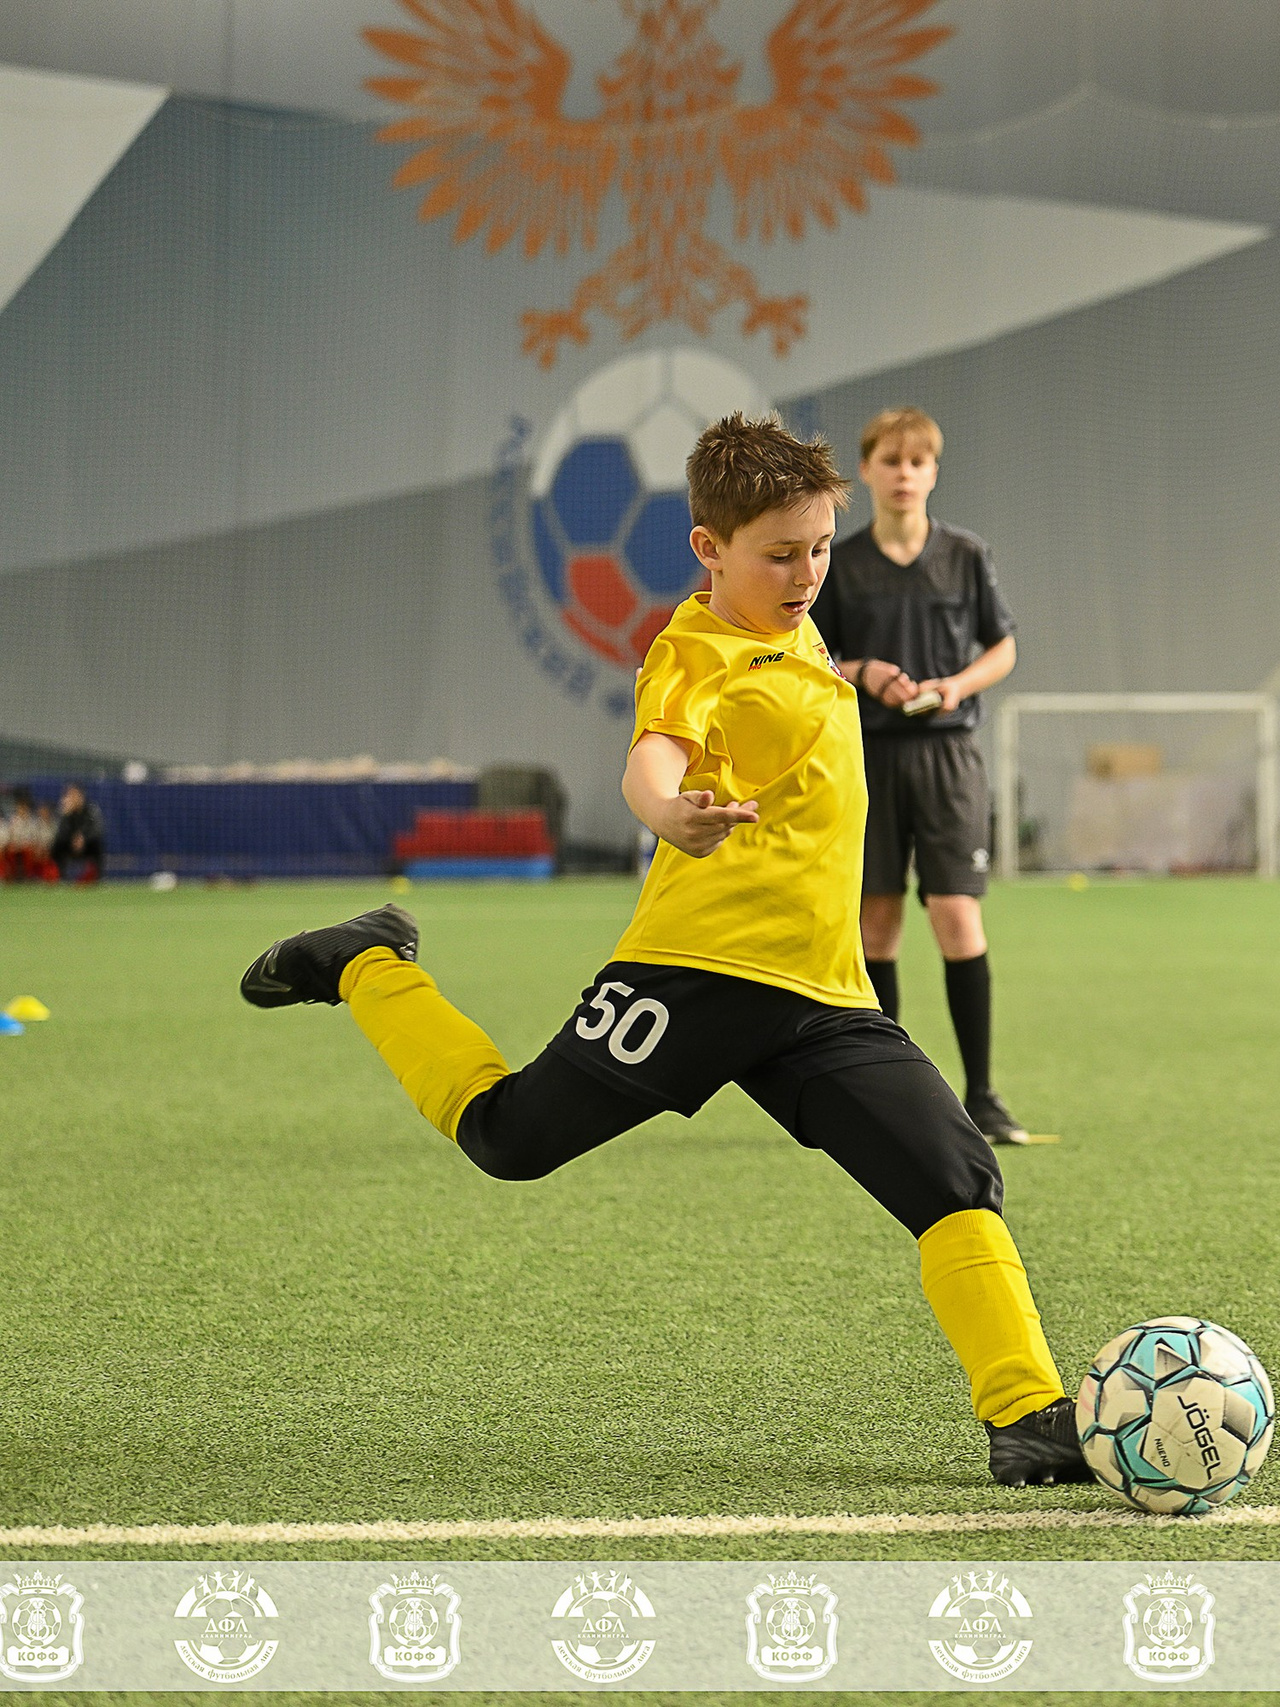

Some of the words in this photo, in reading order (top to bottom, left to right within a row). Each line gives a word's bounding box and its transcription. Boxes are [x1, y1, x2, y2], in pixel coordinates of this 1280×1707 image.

[749, 651, 785, 667] NINE
[575, 981, 670, 1065] 50
[1177, 1395, 1221, 1481] JÖGEL
